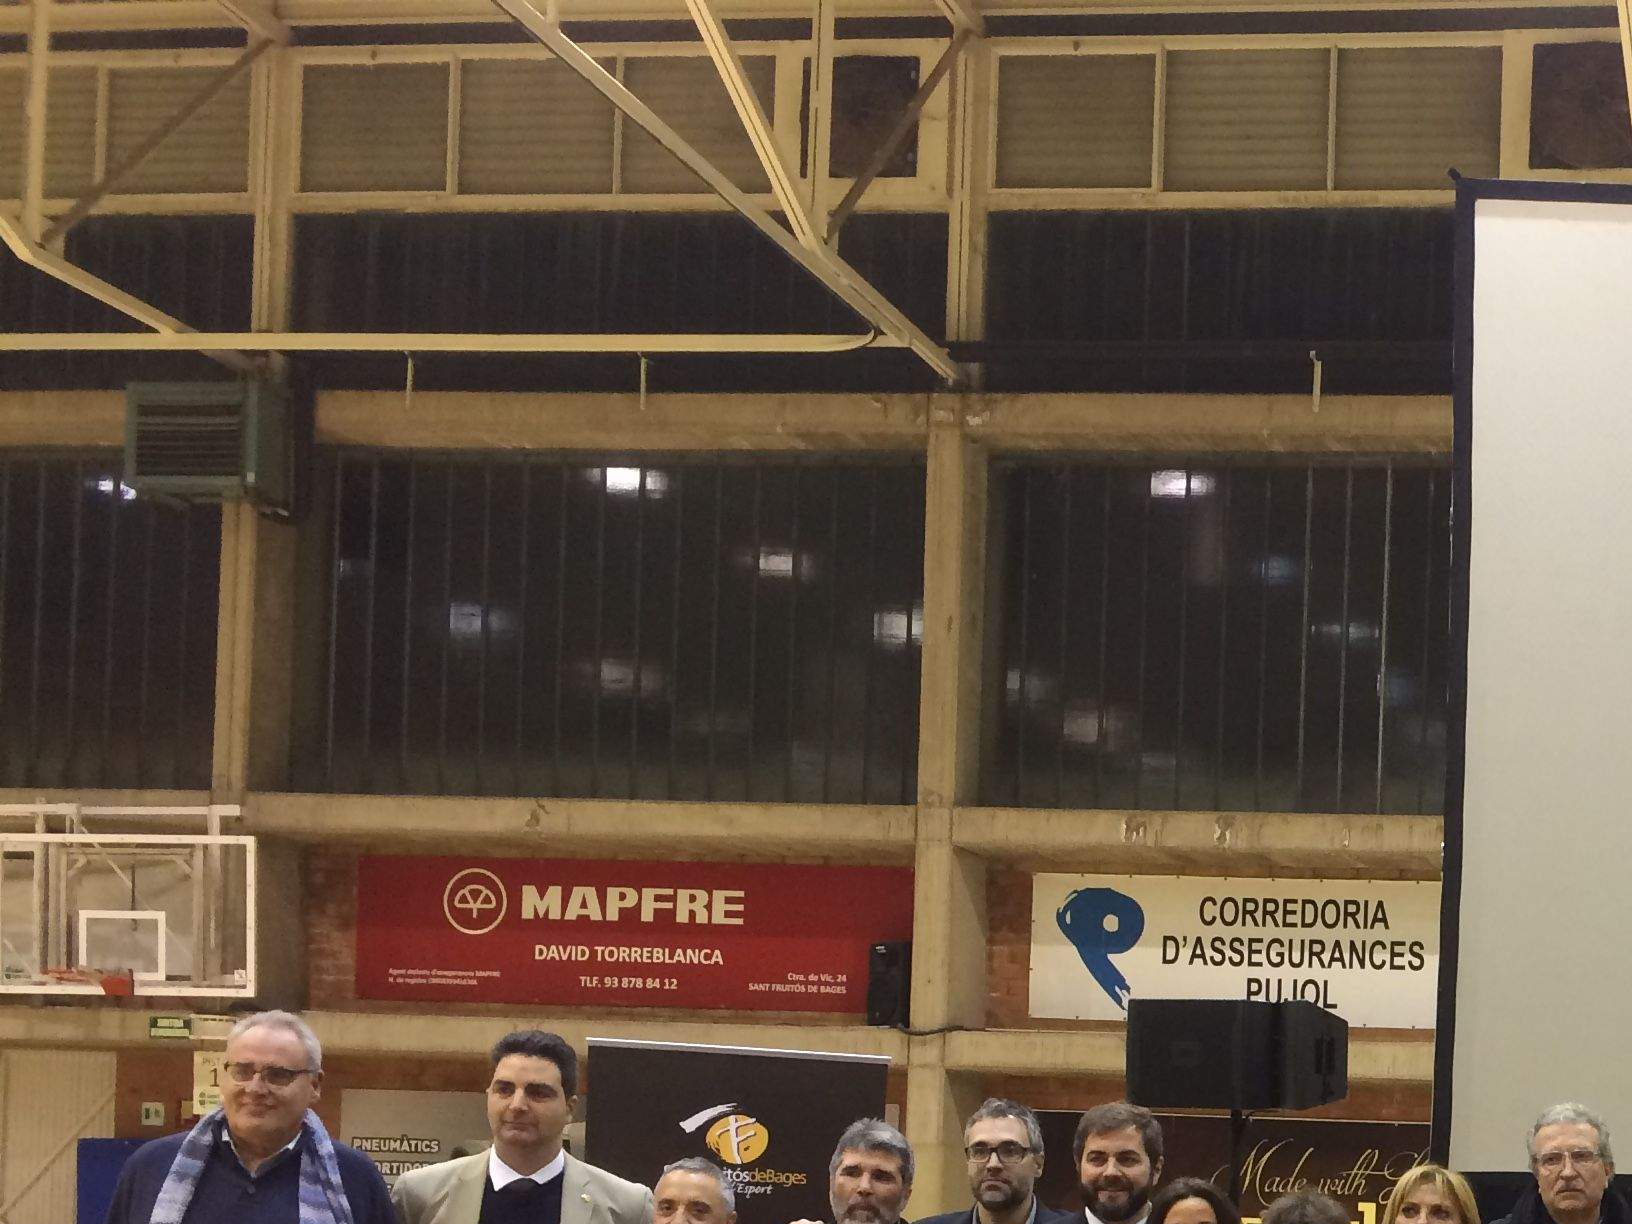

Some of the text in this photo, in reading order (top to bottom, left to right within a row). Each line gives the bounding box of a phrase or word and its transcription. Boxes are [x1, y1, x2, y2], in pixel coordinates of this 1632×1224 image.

[521, 884, 745, 925] MAPFRE
[1198, 895, 1390, 930] CORREDORIA
[534, 944, 724, 966] DAVID TORREBLANCA
[1161, 935, 1425, 971] D'ASSEGURANCES
[579, 975, 678, 990] TLF. 93 878 84 12
[748, 981, 847, 994] SANT FRUITÓS DE BAGES
[787, 972, 806, 981] Ctra.
[808, 973, 819, 981] de
[836, 974, 847, 982] 24
[1246, 977, 1338, 1009] PUJOL
[351, 1134, 440, 1153] PNEUMÀTICS
[1239, 1138, 1314, 1206] Made
[1317, 1148, 1379, 1197] with
